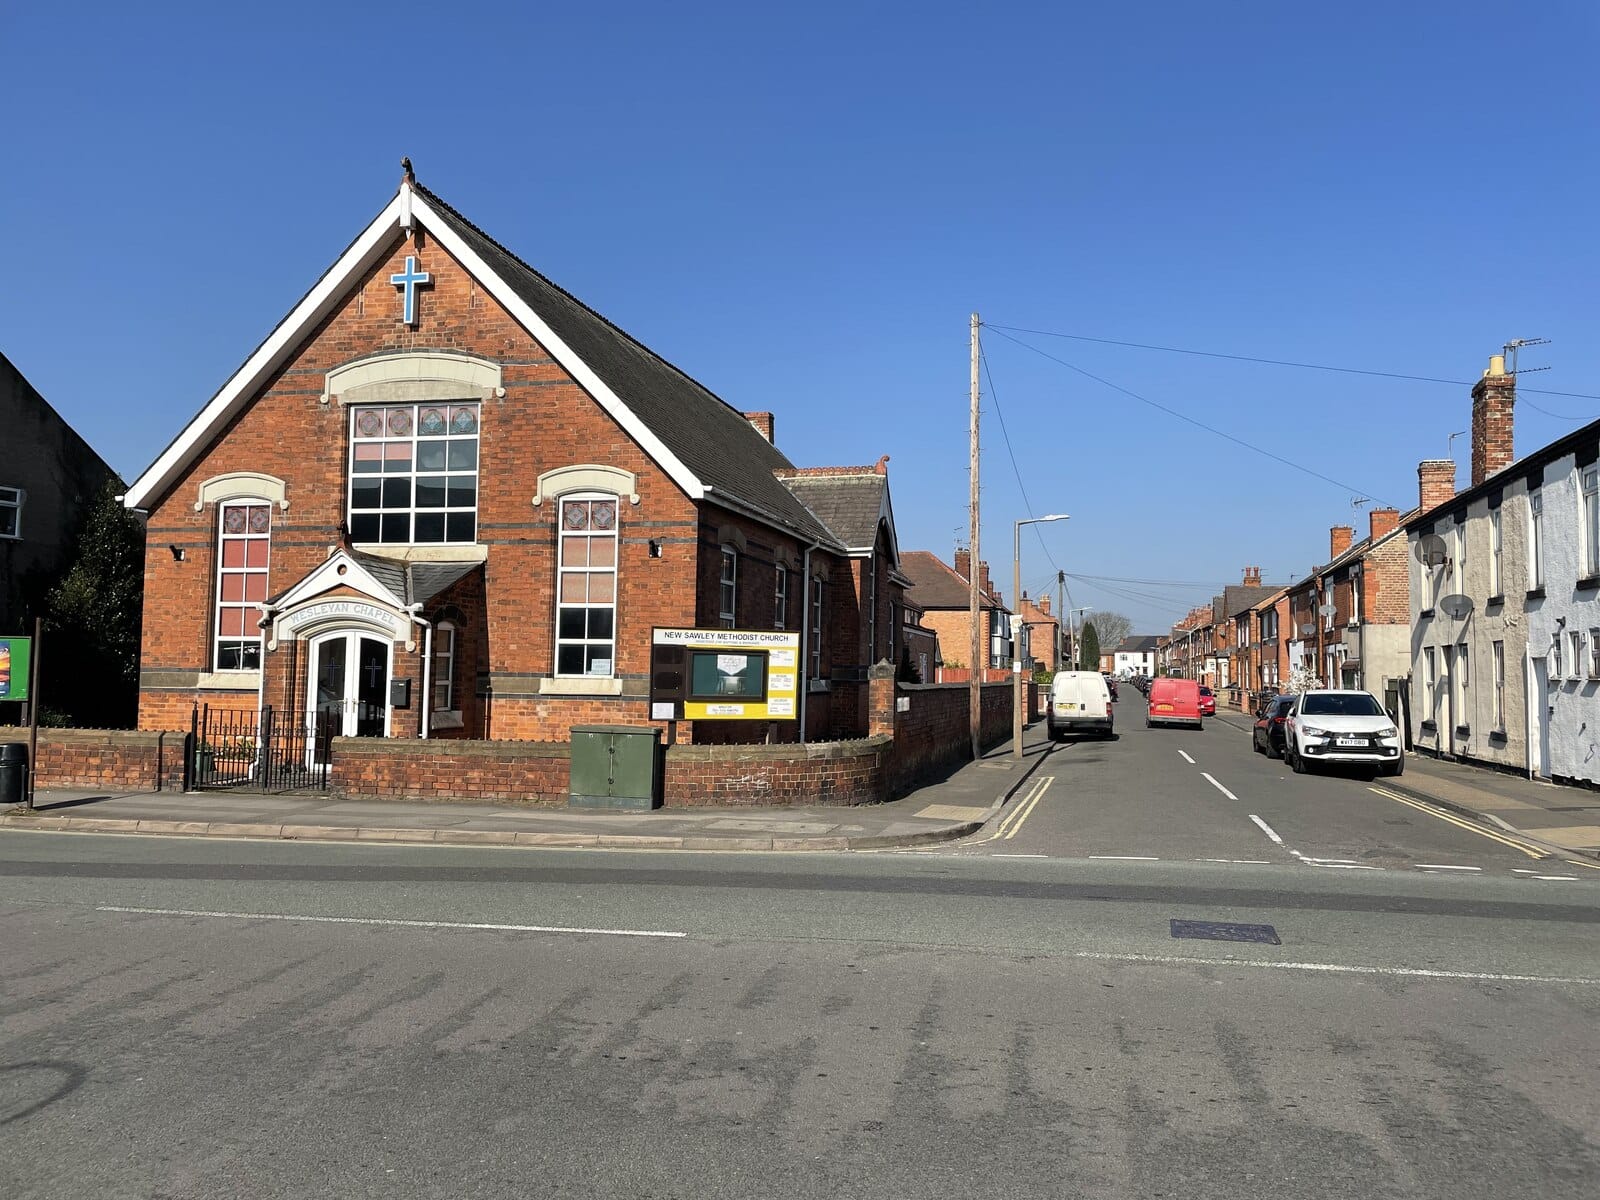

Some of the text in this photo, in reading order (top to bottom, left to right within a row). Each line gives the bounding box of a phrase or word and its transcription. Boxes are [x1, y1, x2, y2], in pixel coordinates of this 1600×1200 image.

[290, 603, 394, 625] WESLEYAN CHAPEL
[664, 631, 682, 639] NEW
[684, 632, 715, 640] SAWLEY
[717, 633, 758, 641] METHODIST
